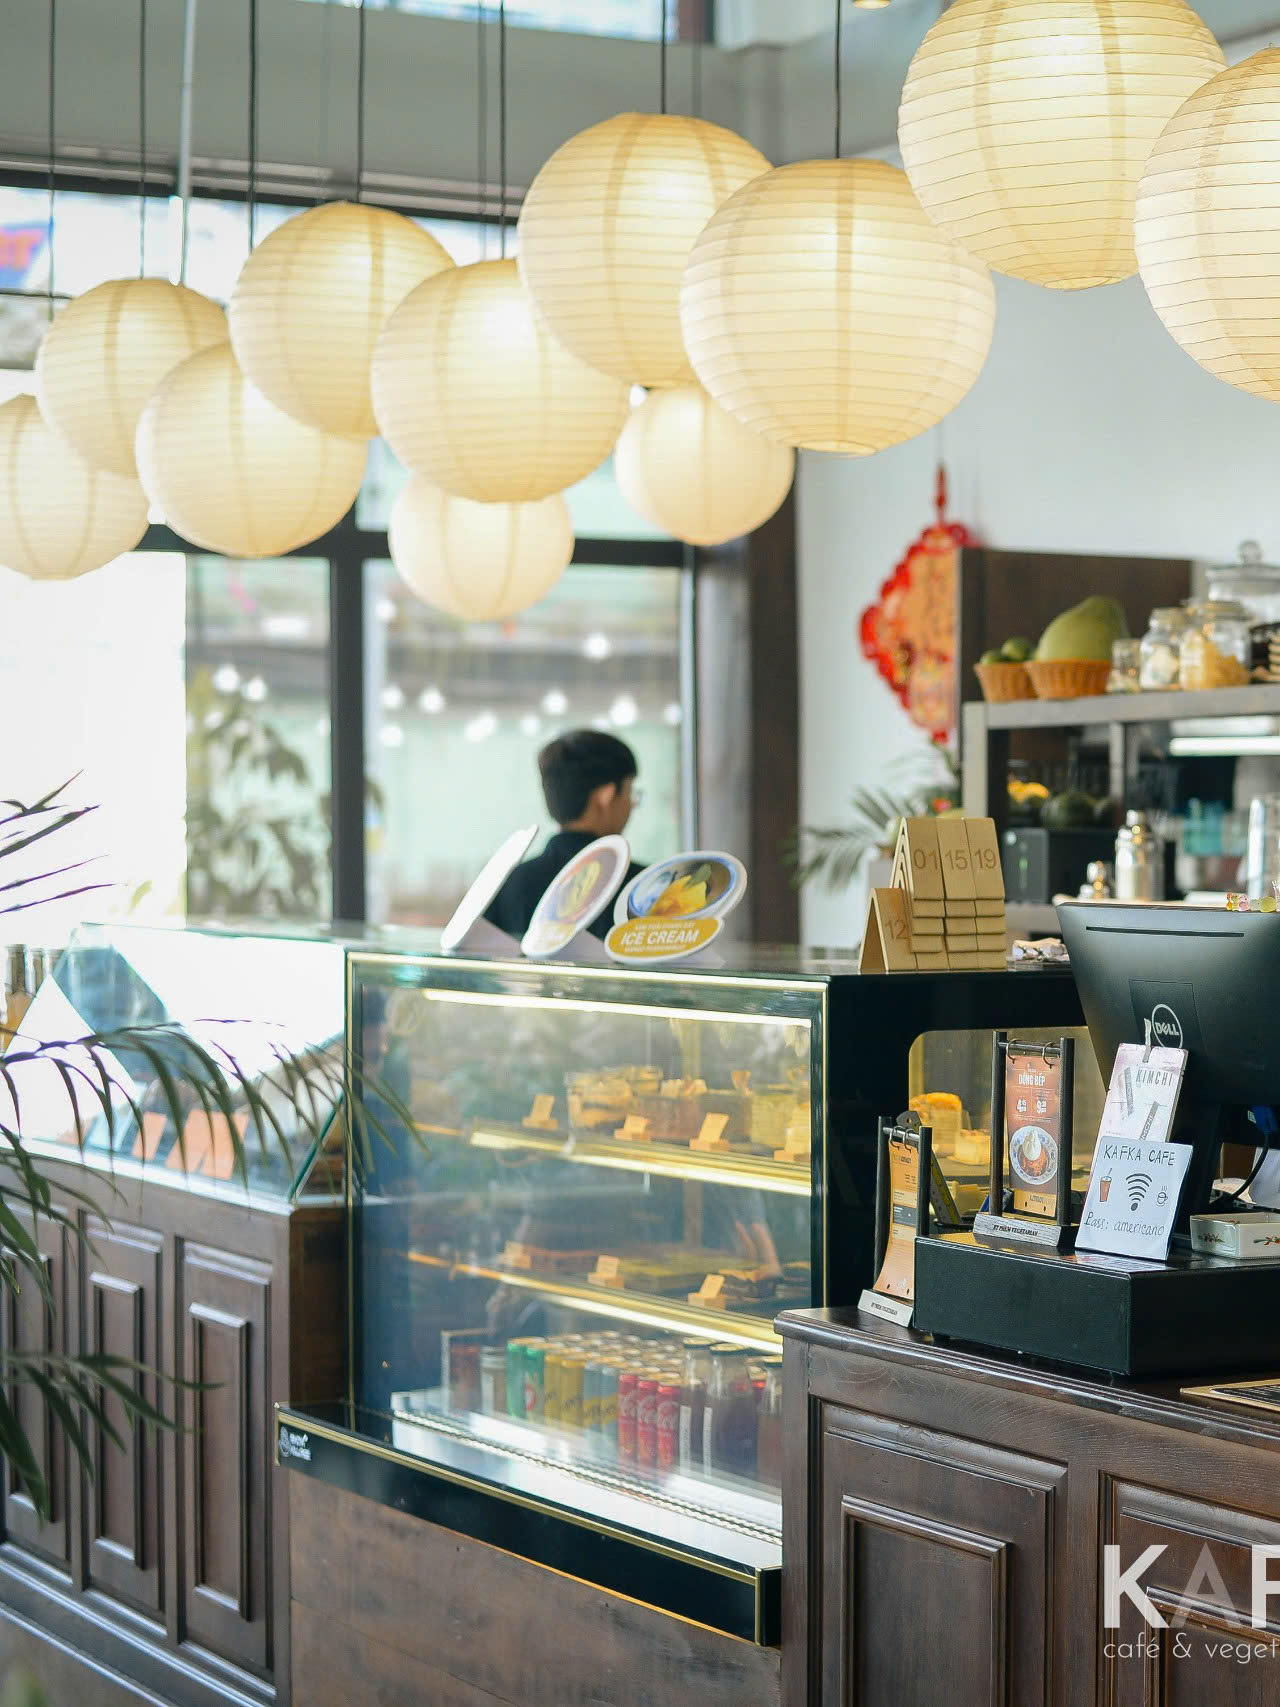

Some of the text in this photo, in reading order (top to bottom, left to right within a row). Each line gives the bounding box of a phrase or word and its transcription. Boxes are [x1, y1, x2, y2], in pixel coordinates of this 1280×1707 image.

[913, 848, 997, 871] 01 15 19
[621, 929, 700, 945] ICE CREAM
[1155, 1022, 1179, 1036] DELL
[1135, 1069, 1173, 1087] KIMCHI
[1103, 1145, 1175, 1166] KAFKA CAFE
[1084, 1211, 1165, 1236] Pass: americano
